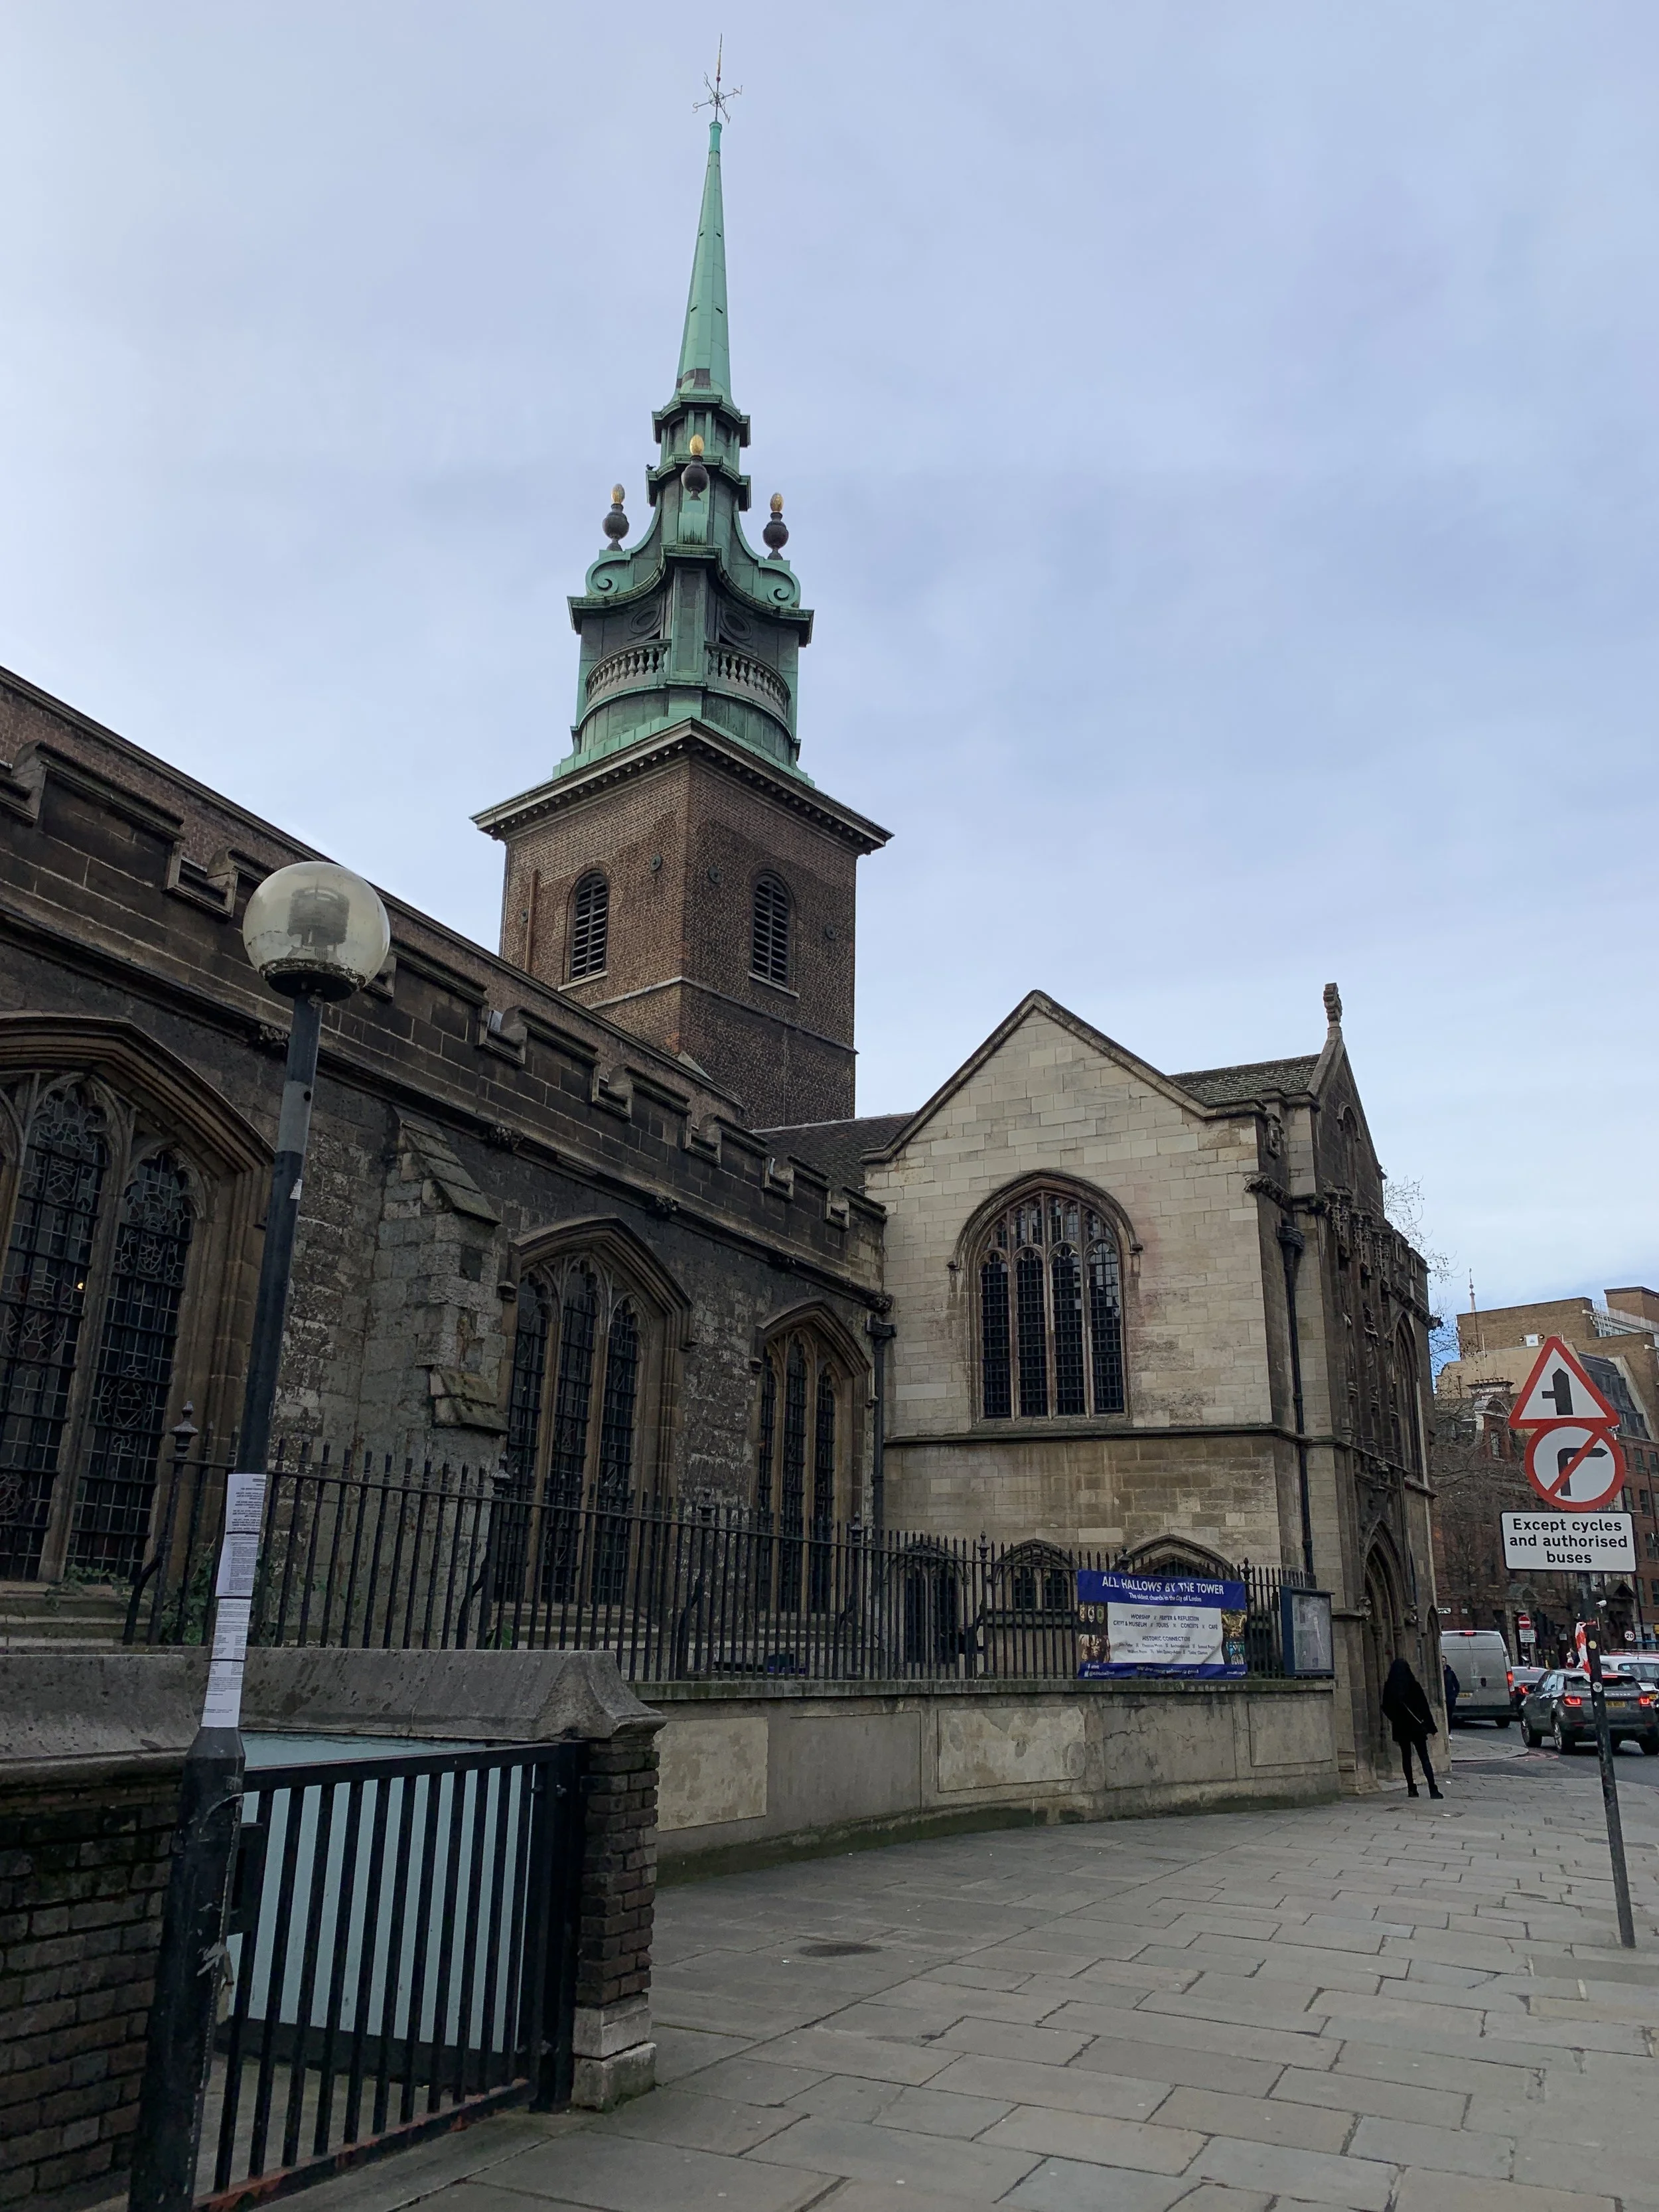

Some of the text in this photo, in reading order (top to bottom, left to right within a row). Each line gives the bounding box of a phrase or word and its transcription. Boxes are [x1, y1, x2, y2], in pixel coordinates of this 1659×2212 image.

[1512, 1518, 1623, 1533] Except cycles
[1509, 1534, 1628, 1548] and authorised
[1546, 1550, 1593, 1564] buses
[1102, 1576, 1224, 1595] ALL HALLOWS BY THE TOWER
